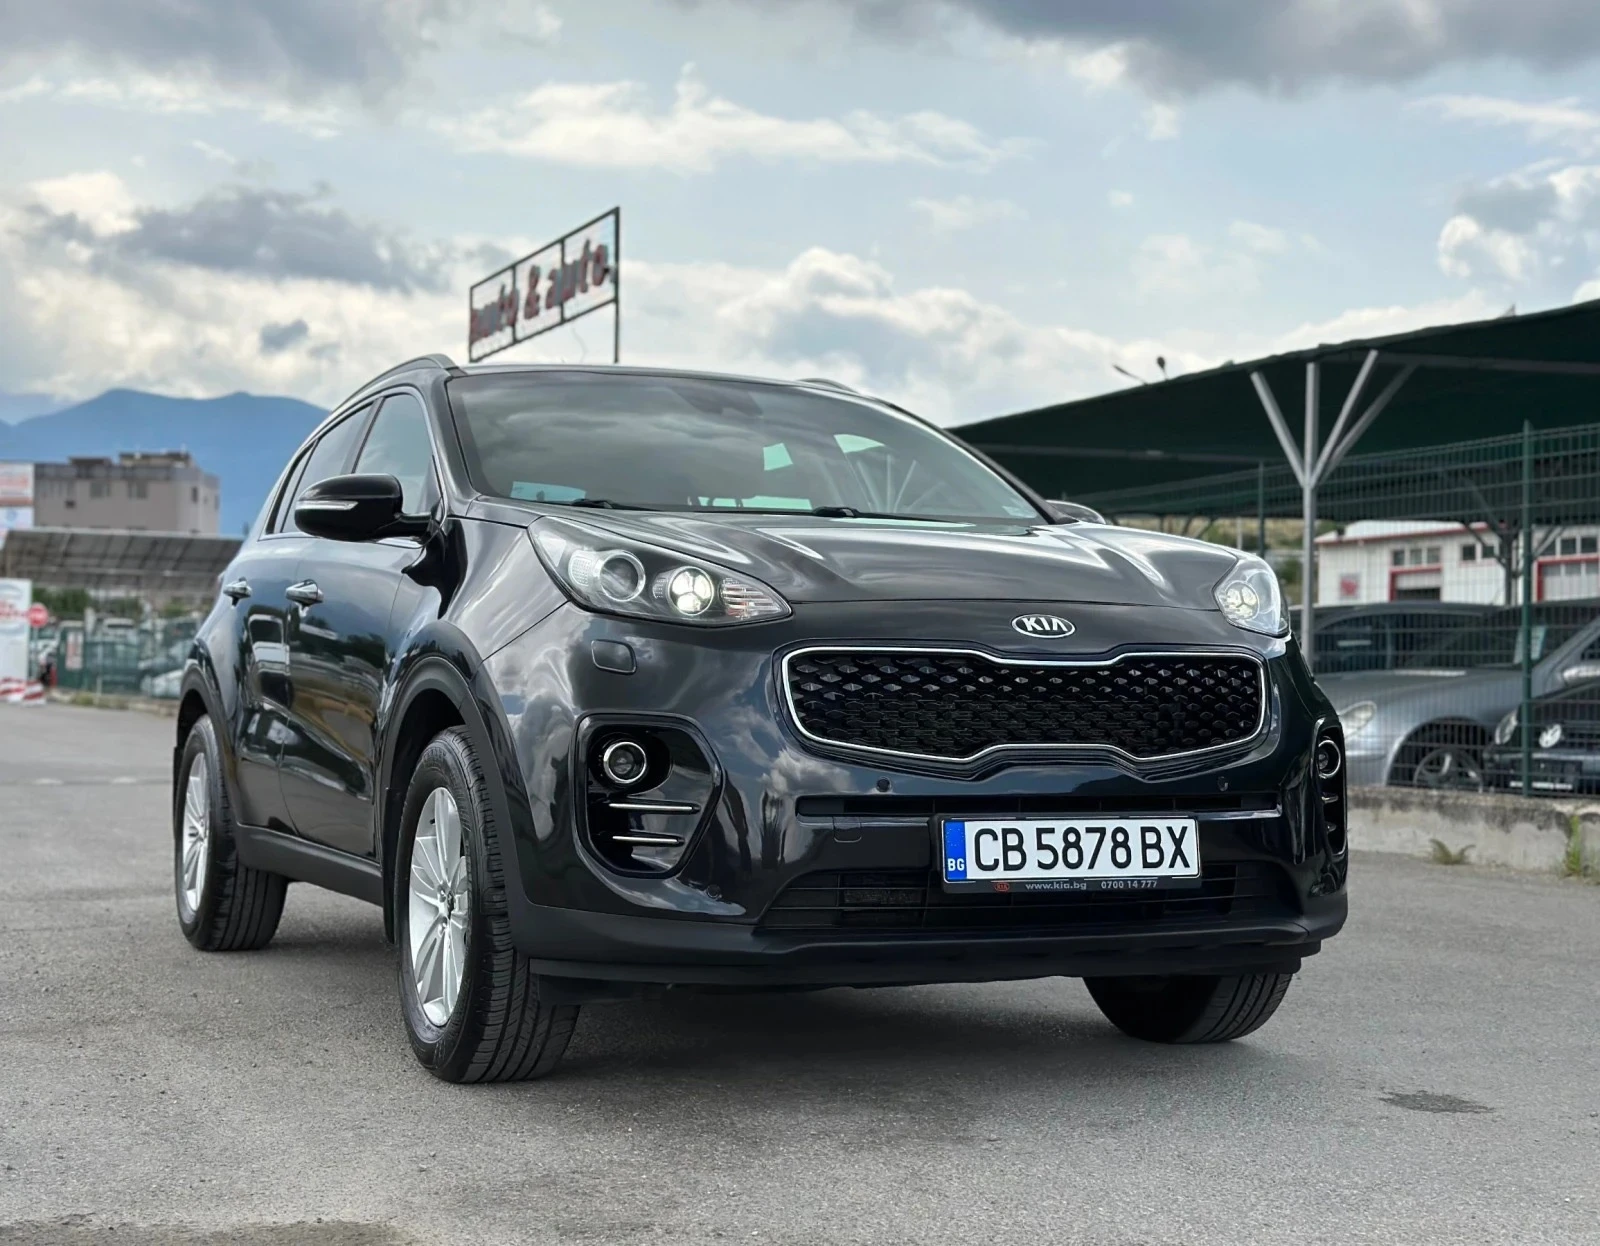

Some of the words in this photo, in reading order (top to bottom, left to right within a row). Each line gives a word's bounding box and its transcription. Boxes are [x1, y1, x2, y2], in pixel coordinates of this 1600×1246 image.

[1021, 617, 1069, 632] KIA
[974, 827, 1027, 872] CB
[1035, 826, 1132, 870] 5878
[1140, 826, 1190, 869] BX
[947, 858, 965, 871] BG
[1025, 881, 1087, 890] www.kia.bg
[1101, 880, 1124, 889] 0700
[1127, 880, 1138, 889] 14
[1141, 880, 1158, 889] 777
